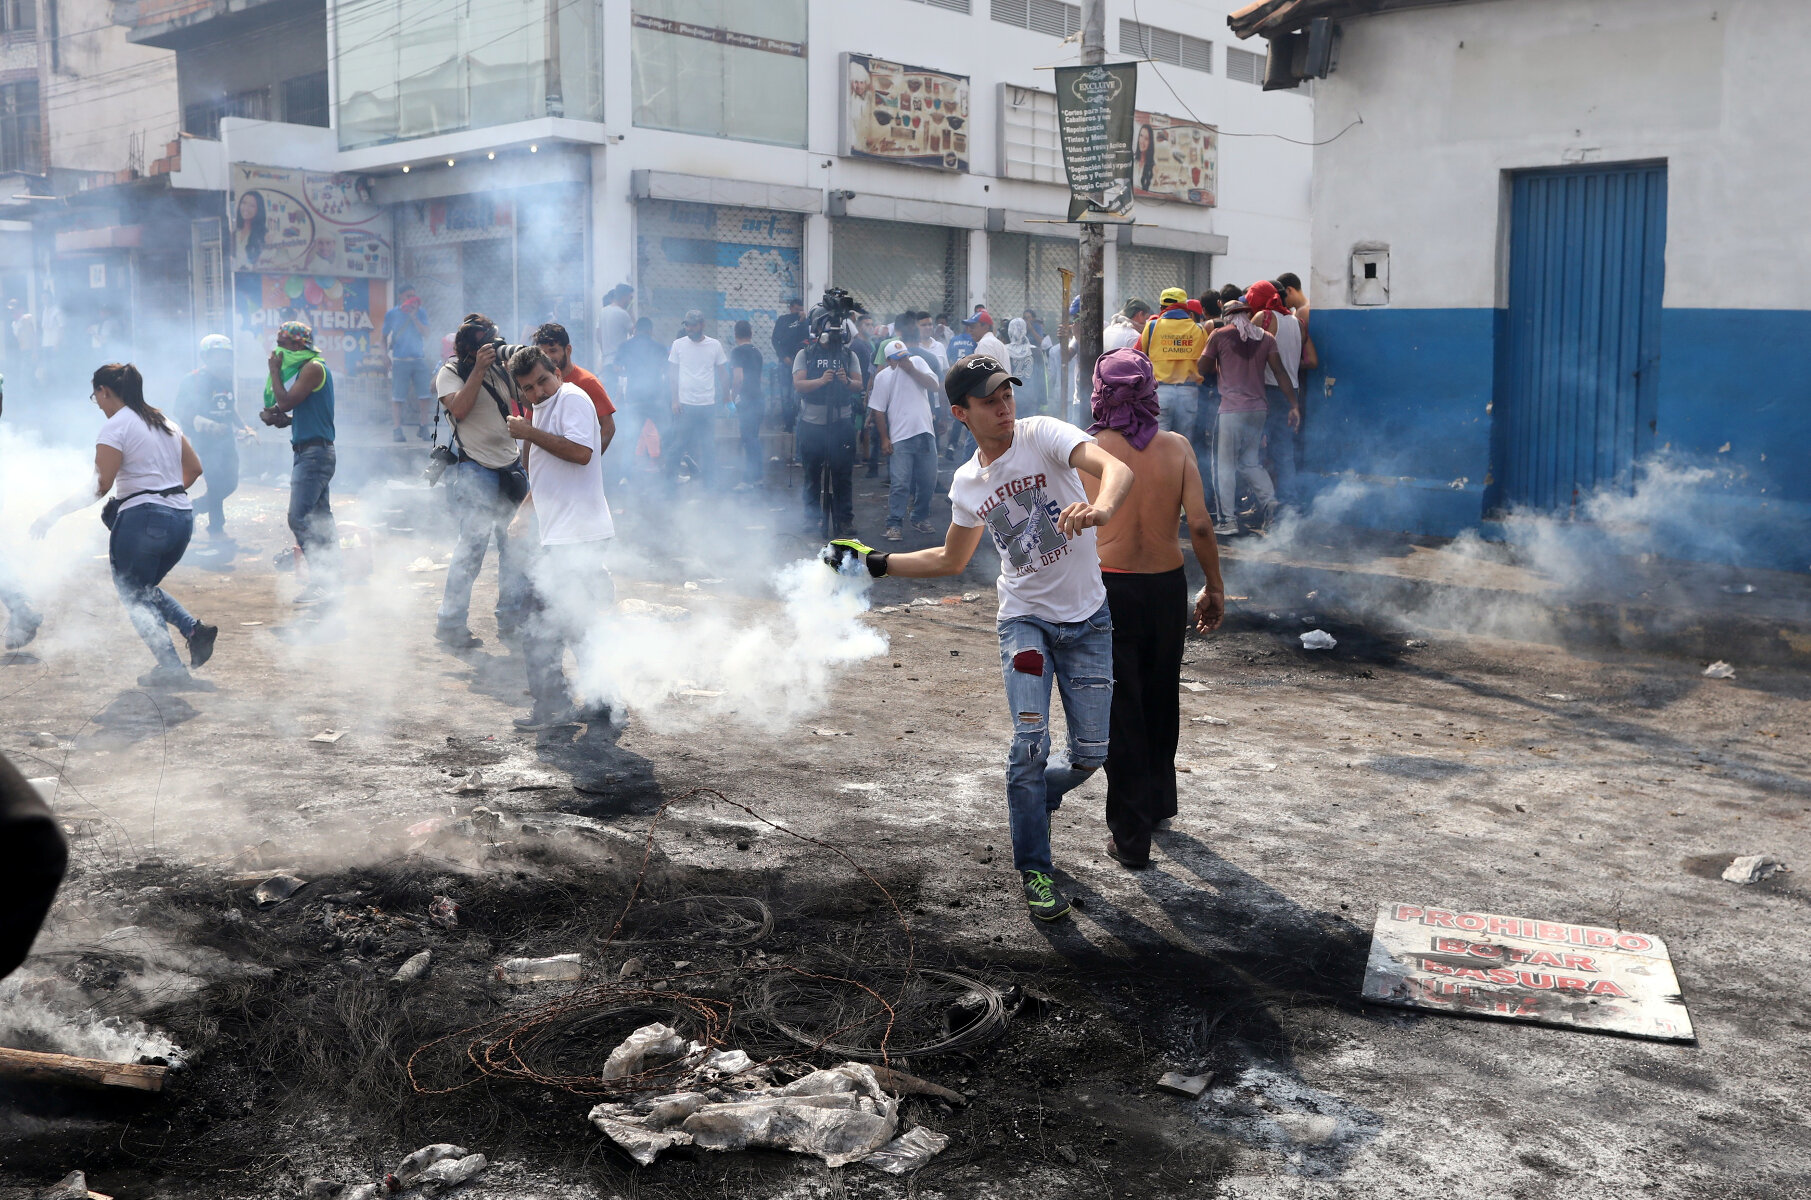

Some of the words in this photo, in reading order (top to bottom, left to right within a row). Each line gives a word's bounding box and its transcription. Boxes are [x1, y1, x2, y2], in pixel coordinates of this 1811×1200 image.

[1065, 115, 1096, 123] Caballeros
[1160, 339, 1193, 347] QUIERE
[976, 472, 1047, 520] HILFIGER
[1039, 544, 1073, 567] DEPT.
[1391, 903, 1656, 951] PROHIBIDO
[1430, 936, 1599, 972] BOTAR
[1416, 957, 1631, 999] BASURA
